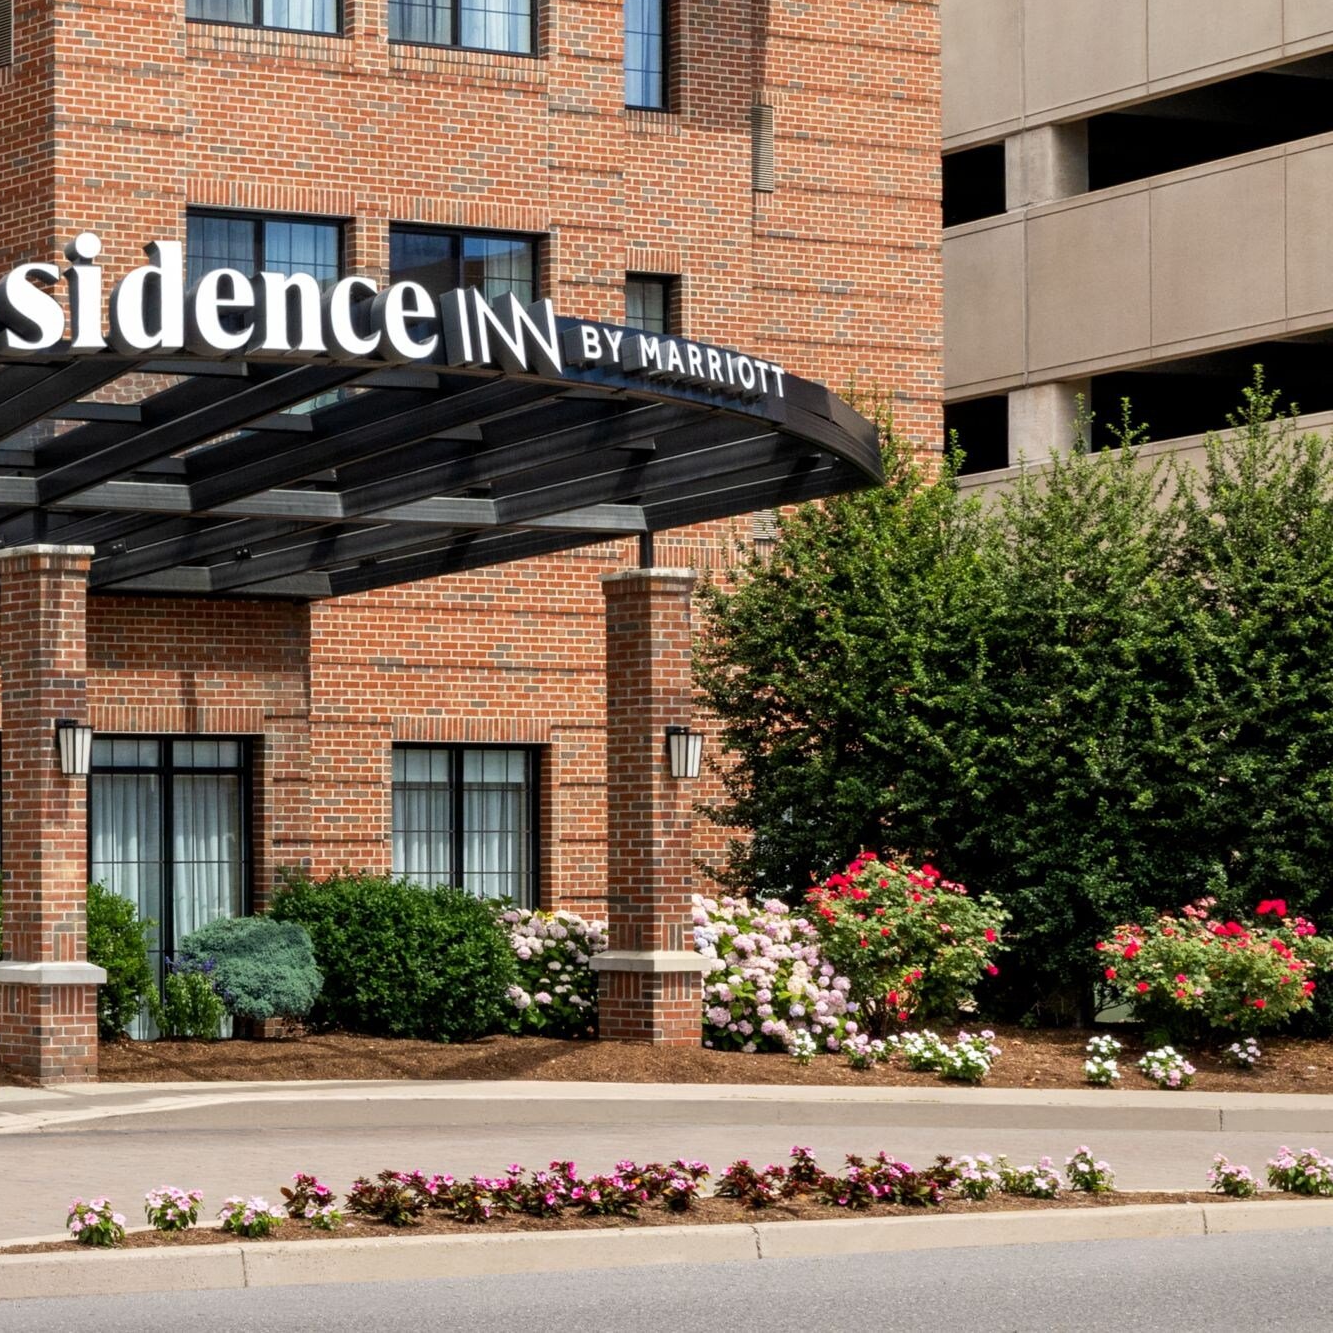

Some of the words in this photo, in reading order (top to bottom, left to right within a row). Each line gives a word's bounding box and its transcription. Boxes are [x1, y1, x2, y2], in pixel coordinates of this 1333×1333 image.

[455, 287, 564, 375] INN
[580, 324, 624, 364] BY
[638, 333, 786, 399] MARRIOTT
